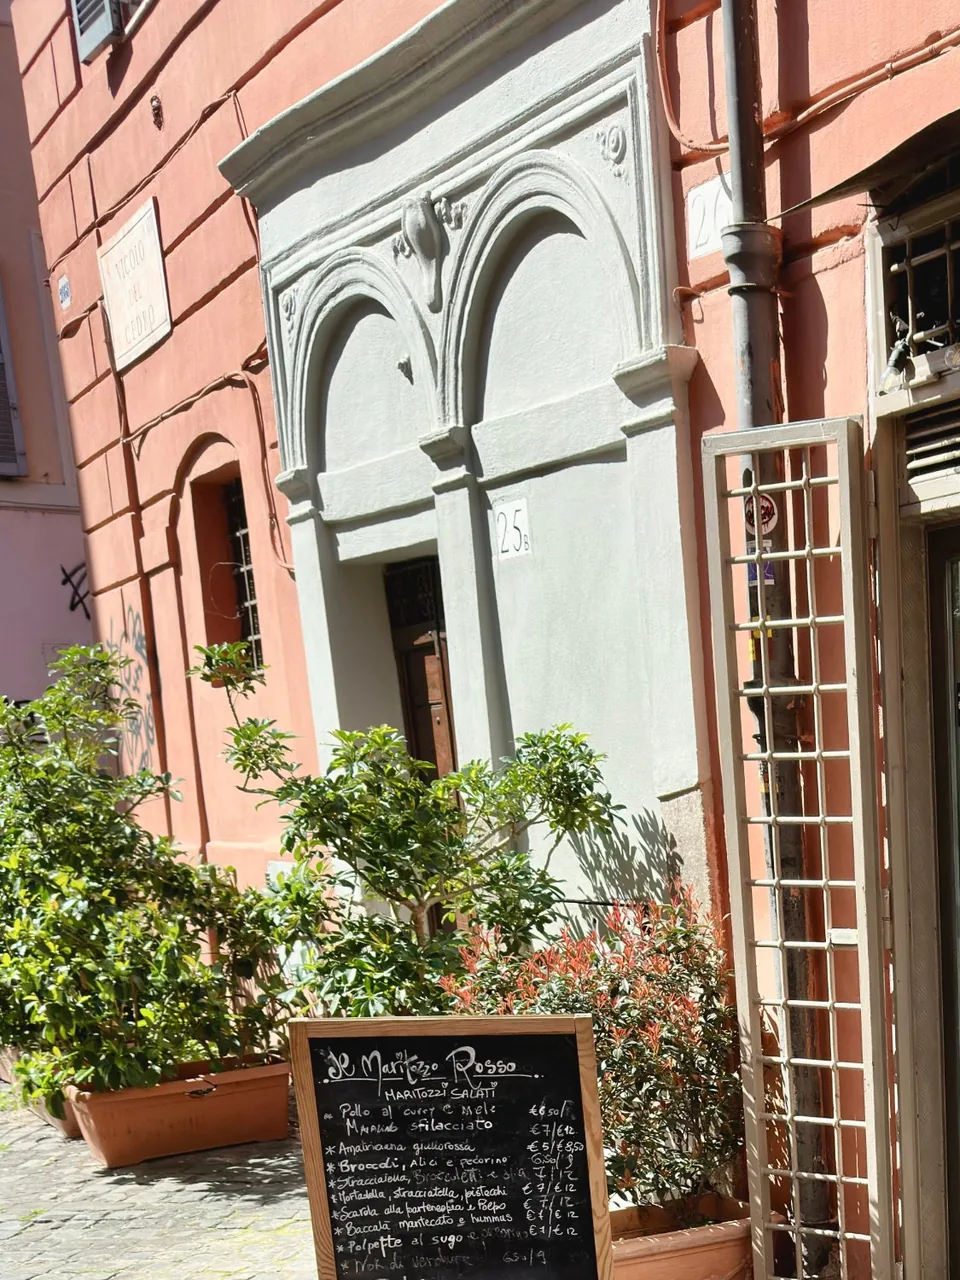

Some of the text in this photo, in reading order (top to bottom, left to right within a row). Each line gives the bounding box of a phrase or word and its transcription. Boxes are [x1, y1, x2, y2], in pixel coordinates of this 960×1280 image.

[115, 240, 145, 280] VICOLO
[128, 281, 143, 306] DEL
[446, 1046, 517, 1090] Rosso
[339, 1103, 370, 1119] Pollo
[381, 1104, 393, 1119] al
[410, 1117, 493, 1132] sfilacciato
[339, 1205, 379, 1221] Scarola
[383, 1203, 405, 1216] alla
[398, 1213, 454, 1232] mantecato
[348, 1234, 404, 1258] Polpette
[411, 1232, 424, 1246] al
[431, 1234, 464, 1250] sugo
